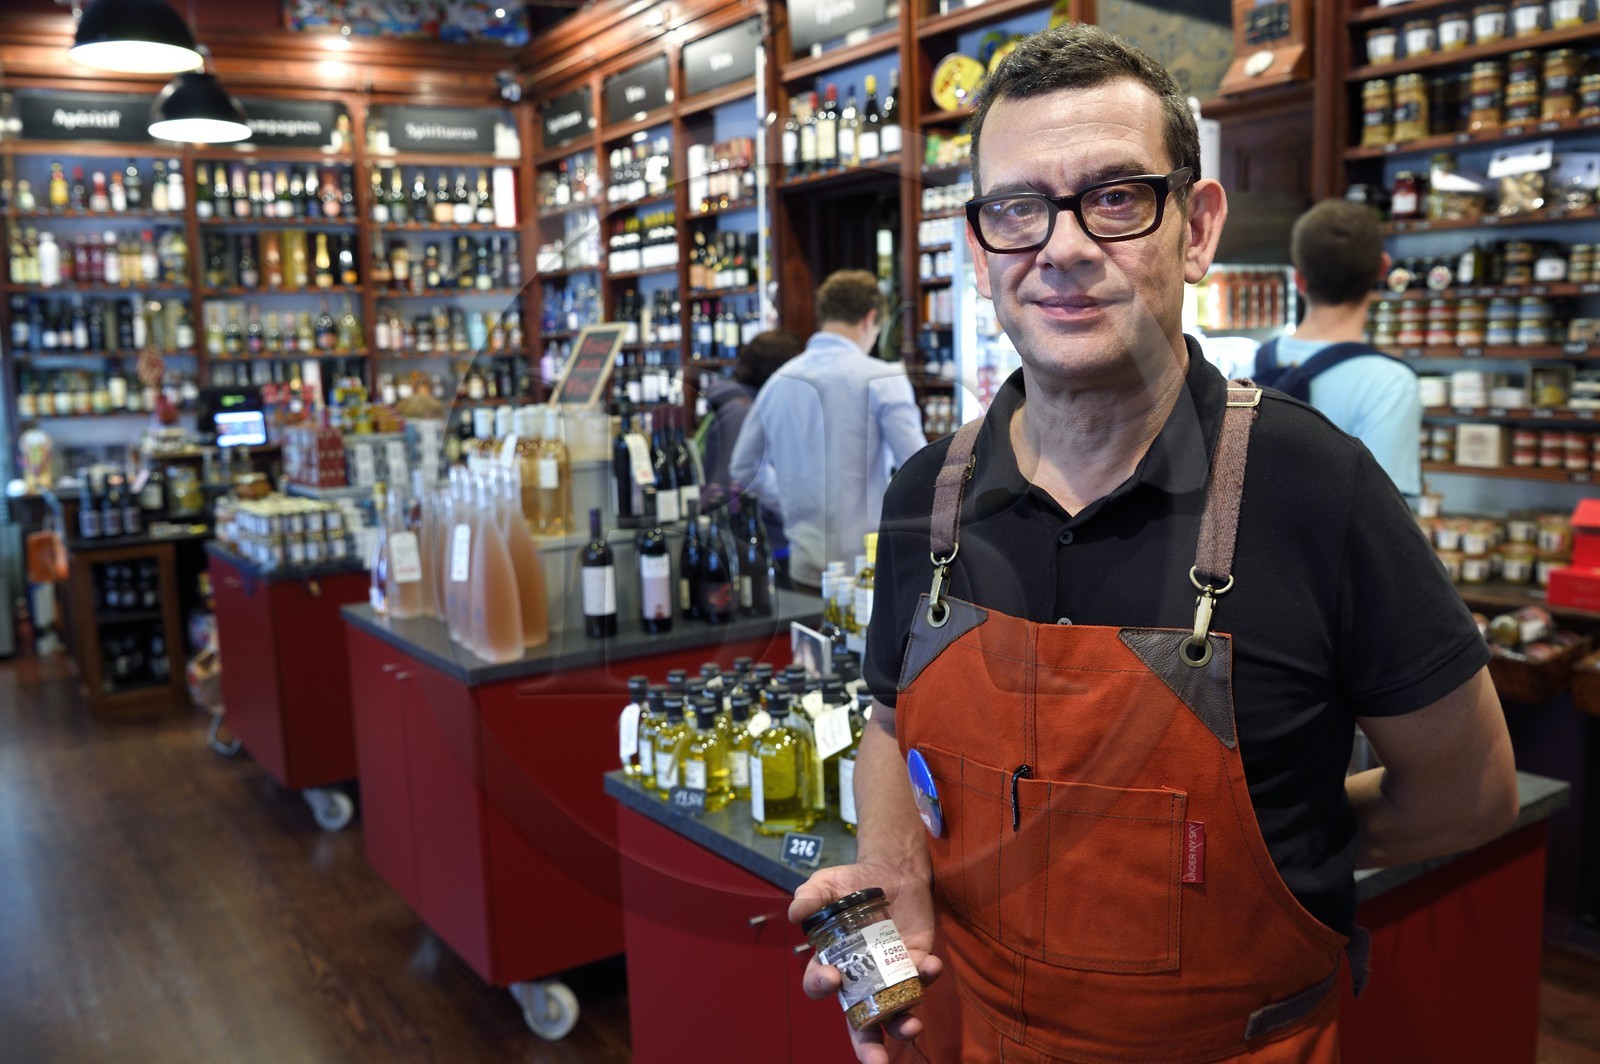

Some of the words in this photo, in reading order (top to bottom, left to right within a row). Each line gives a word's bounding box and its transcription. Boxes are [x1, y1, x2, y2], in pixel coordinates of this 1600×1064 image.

[1189, 823, 1202, 839] SKY
[789, 838, 816, 857] 27€
[1183, 853, 1197, 881] UNDER
